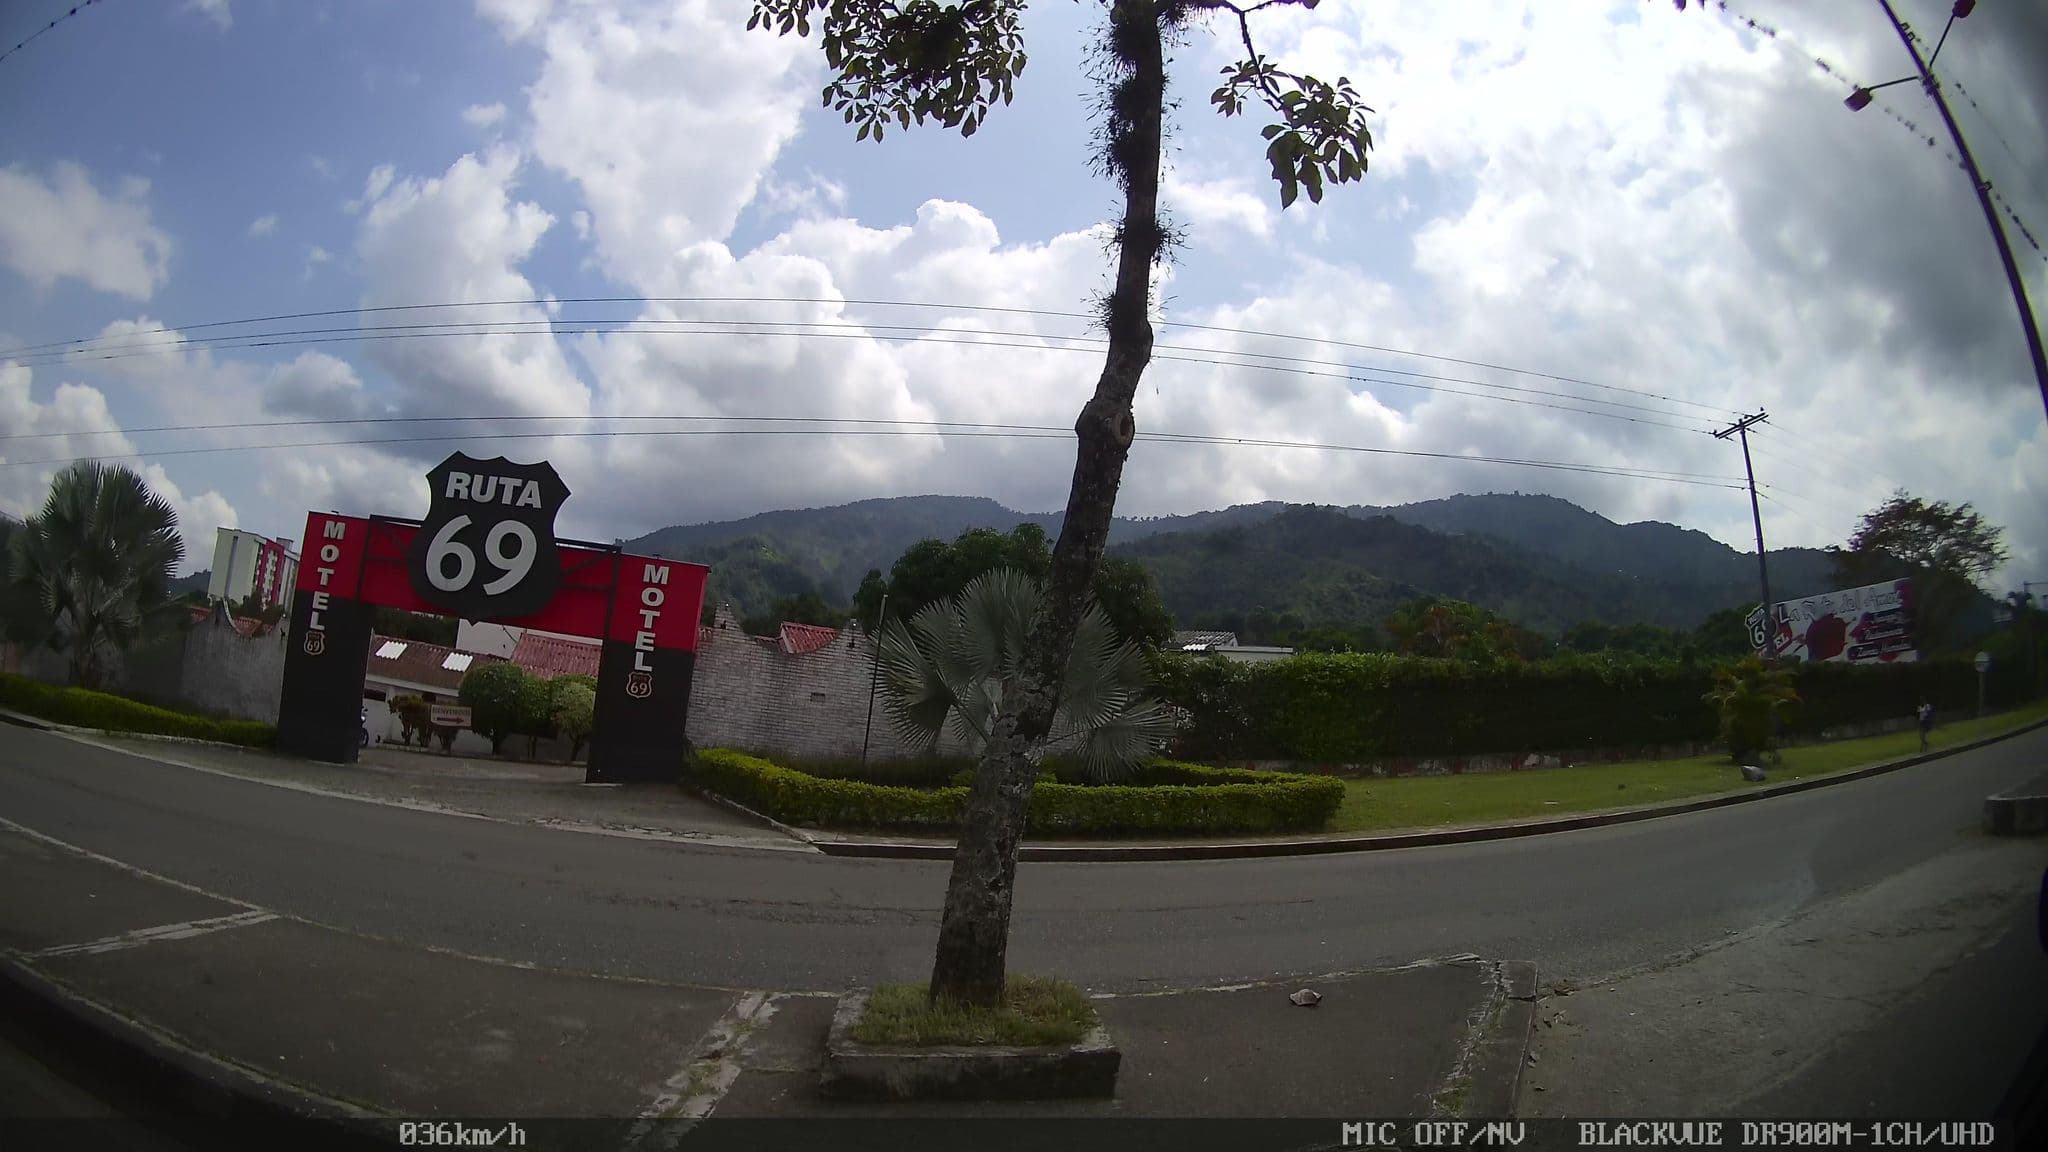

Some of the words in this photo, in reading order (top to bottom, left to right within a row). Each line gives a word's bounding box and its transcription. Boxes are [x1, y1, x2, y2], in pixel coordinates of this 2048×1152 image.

[445, 471, 543, 509] RUTA
[310, 520, 346, 631] MOTEL
[425, 514, 538, 597] 69
[307, 640, 320, 652] 69
[633, 563, 670, 672] MOTEL
[631, 681, 648, 694] 69
